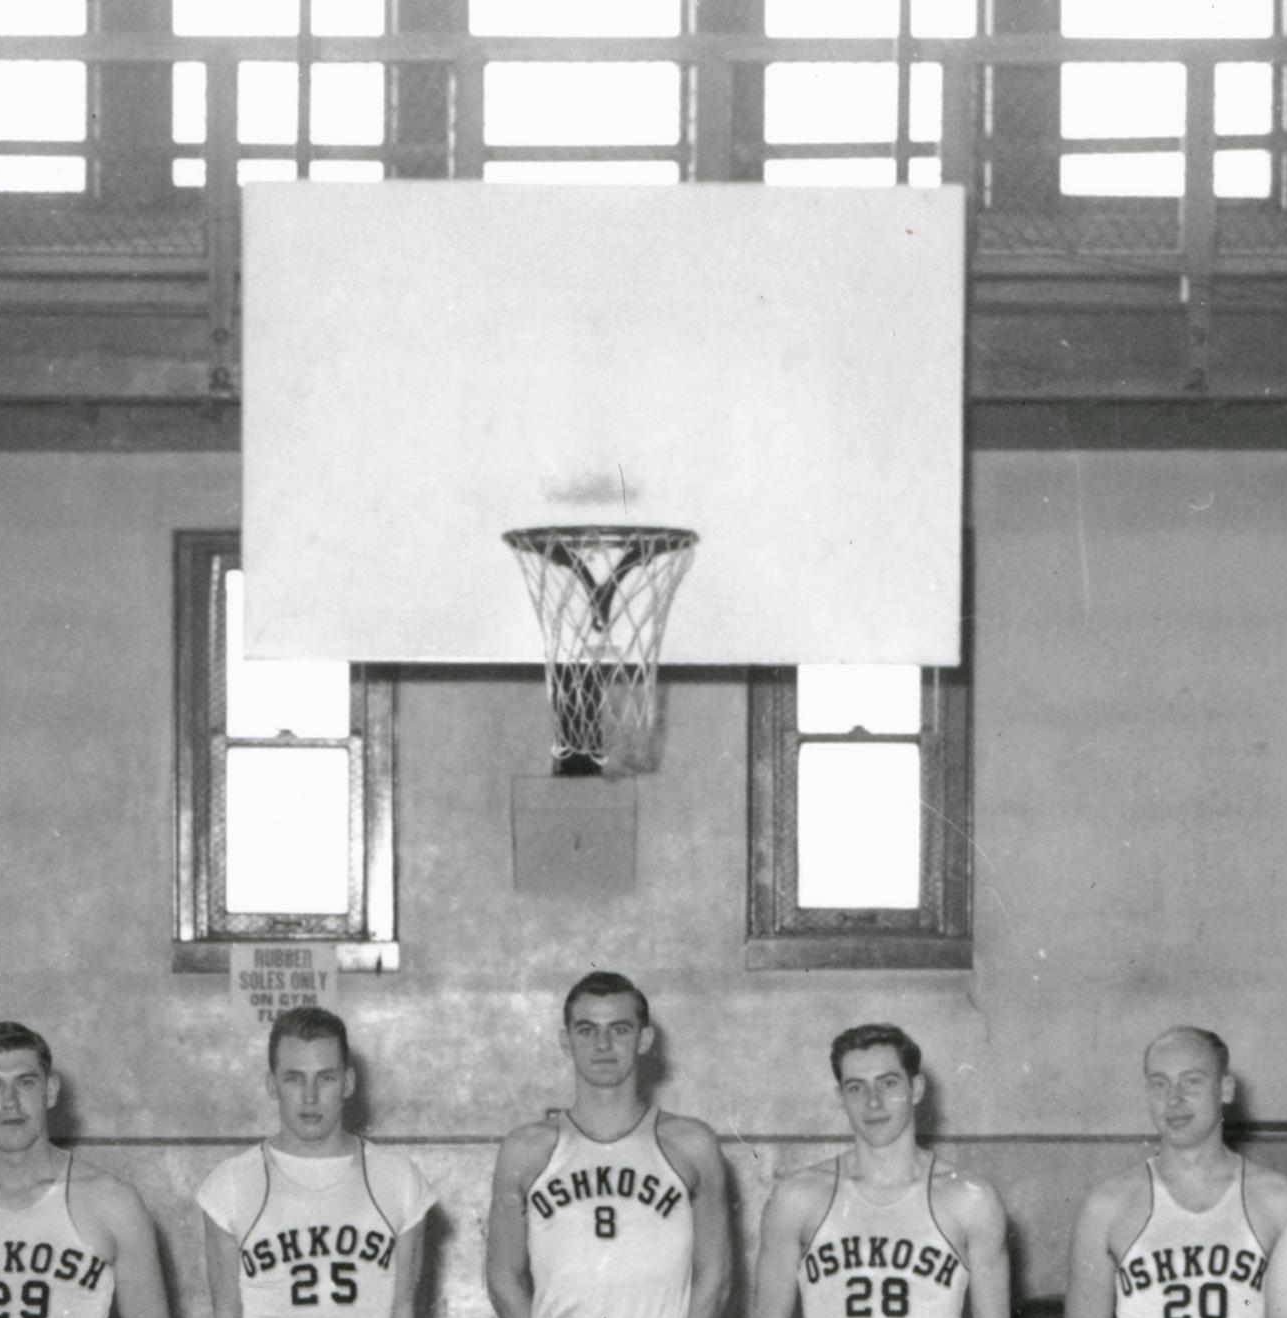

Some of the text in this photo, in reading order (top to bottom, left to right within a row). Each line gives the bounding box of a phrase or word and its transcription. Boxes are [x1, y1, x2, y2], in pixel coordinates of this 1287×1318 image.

[254, 948, 313, 968] RUBBER
[239, 970, 328, 990] SOLES ONLY
[250, 993, 317, 1007] ON GYM
[530, 1165, 682, 1219] OSHKOSH
[594, 1206, 616, 1239] 8
[241, 1225, 396, 1278] OSHKOSH
[804, 1235, 960, 1288] OSHKOSH
[1119, 1244, 1269, 1297] OSHKOSH
[290, 1262, 358, 1305] 25
[846, 1276, 910, 1318] 28
